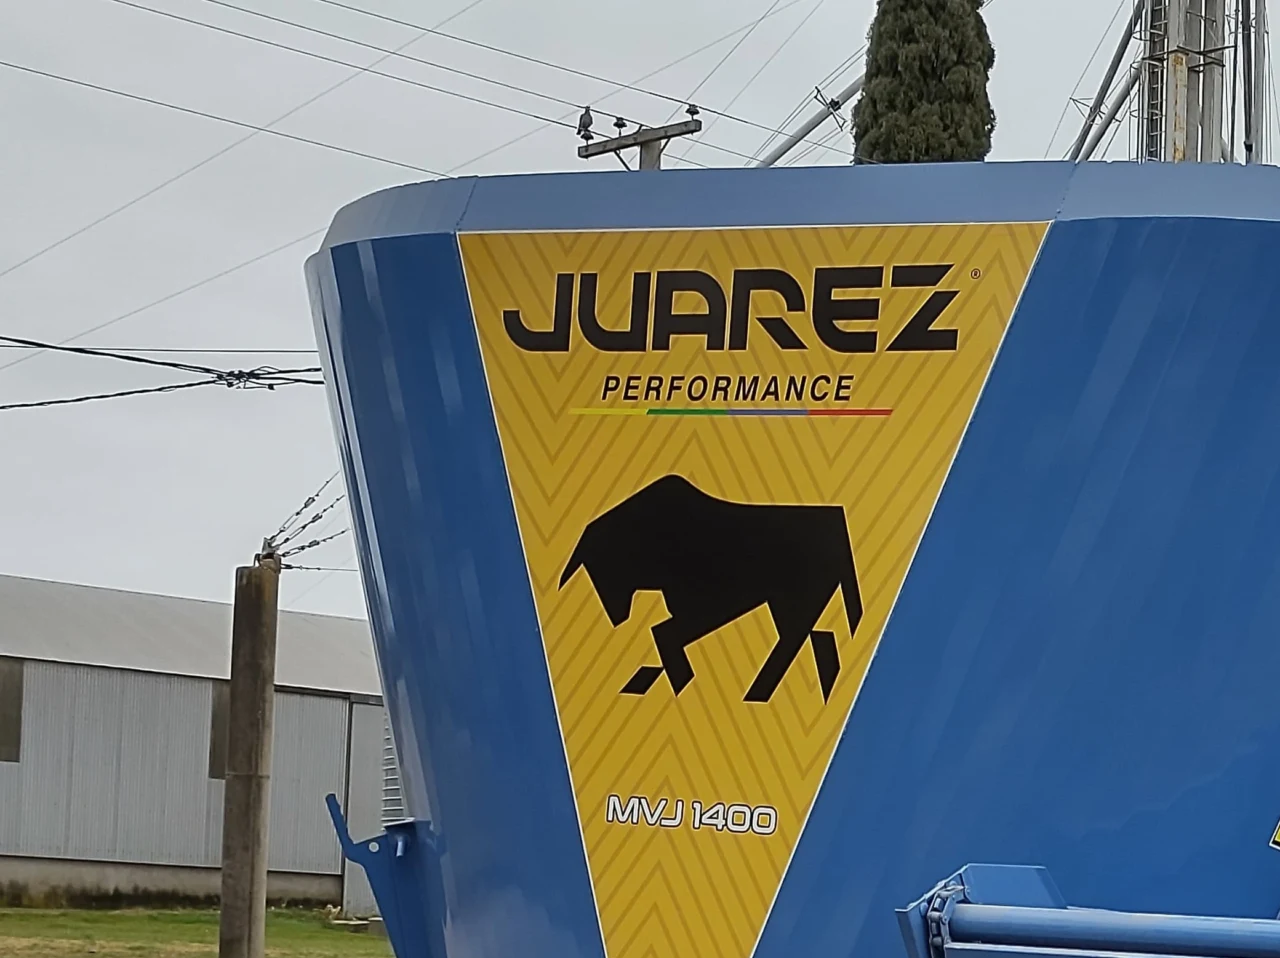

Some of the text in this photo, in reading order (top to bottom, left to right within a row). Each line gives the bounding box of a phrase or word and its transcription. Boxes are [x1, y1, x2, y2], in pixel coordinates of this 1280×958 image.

[502, 264, 961, 353] JUAREZ
[601, 375, 855, 402] PERFORMANCE
[607, 795, 777, 835] MVJ 1400
